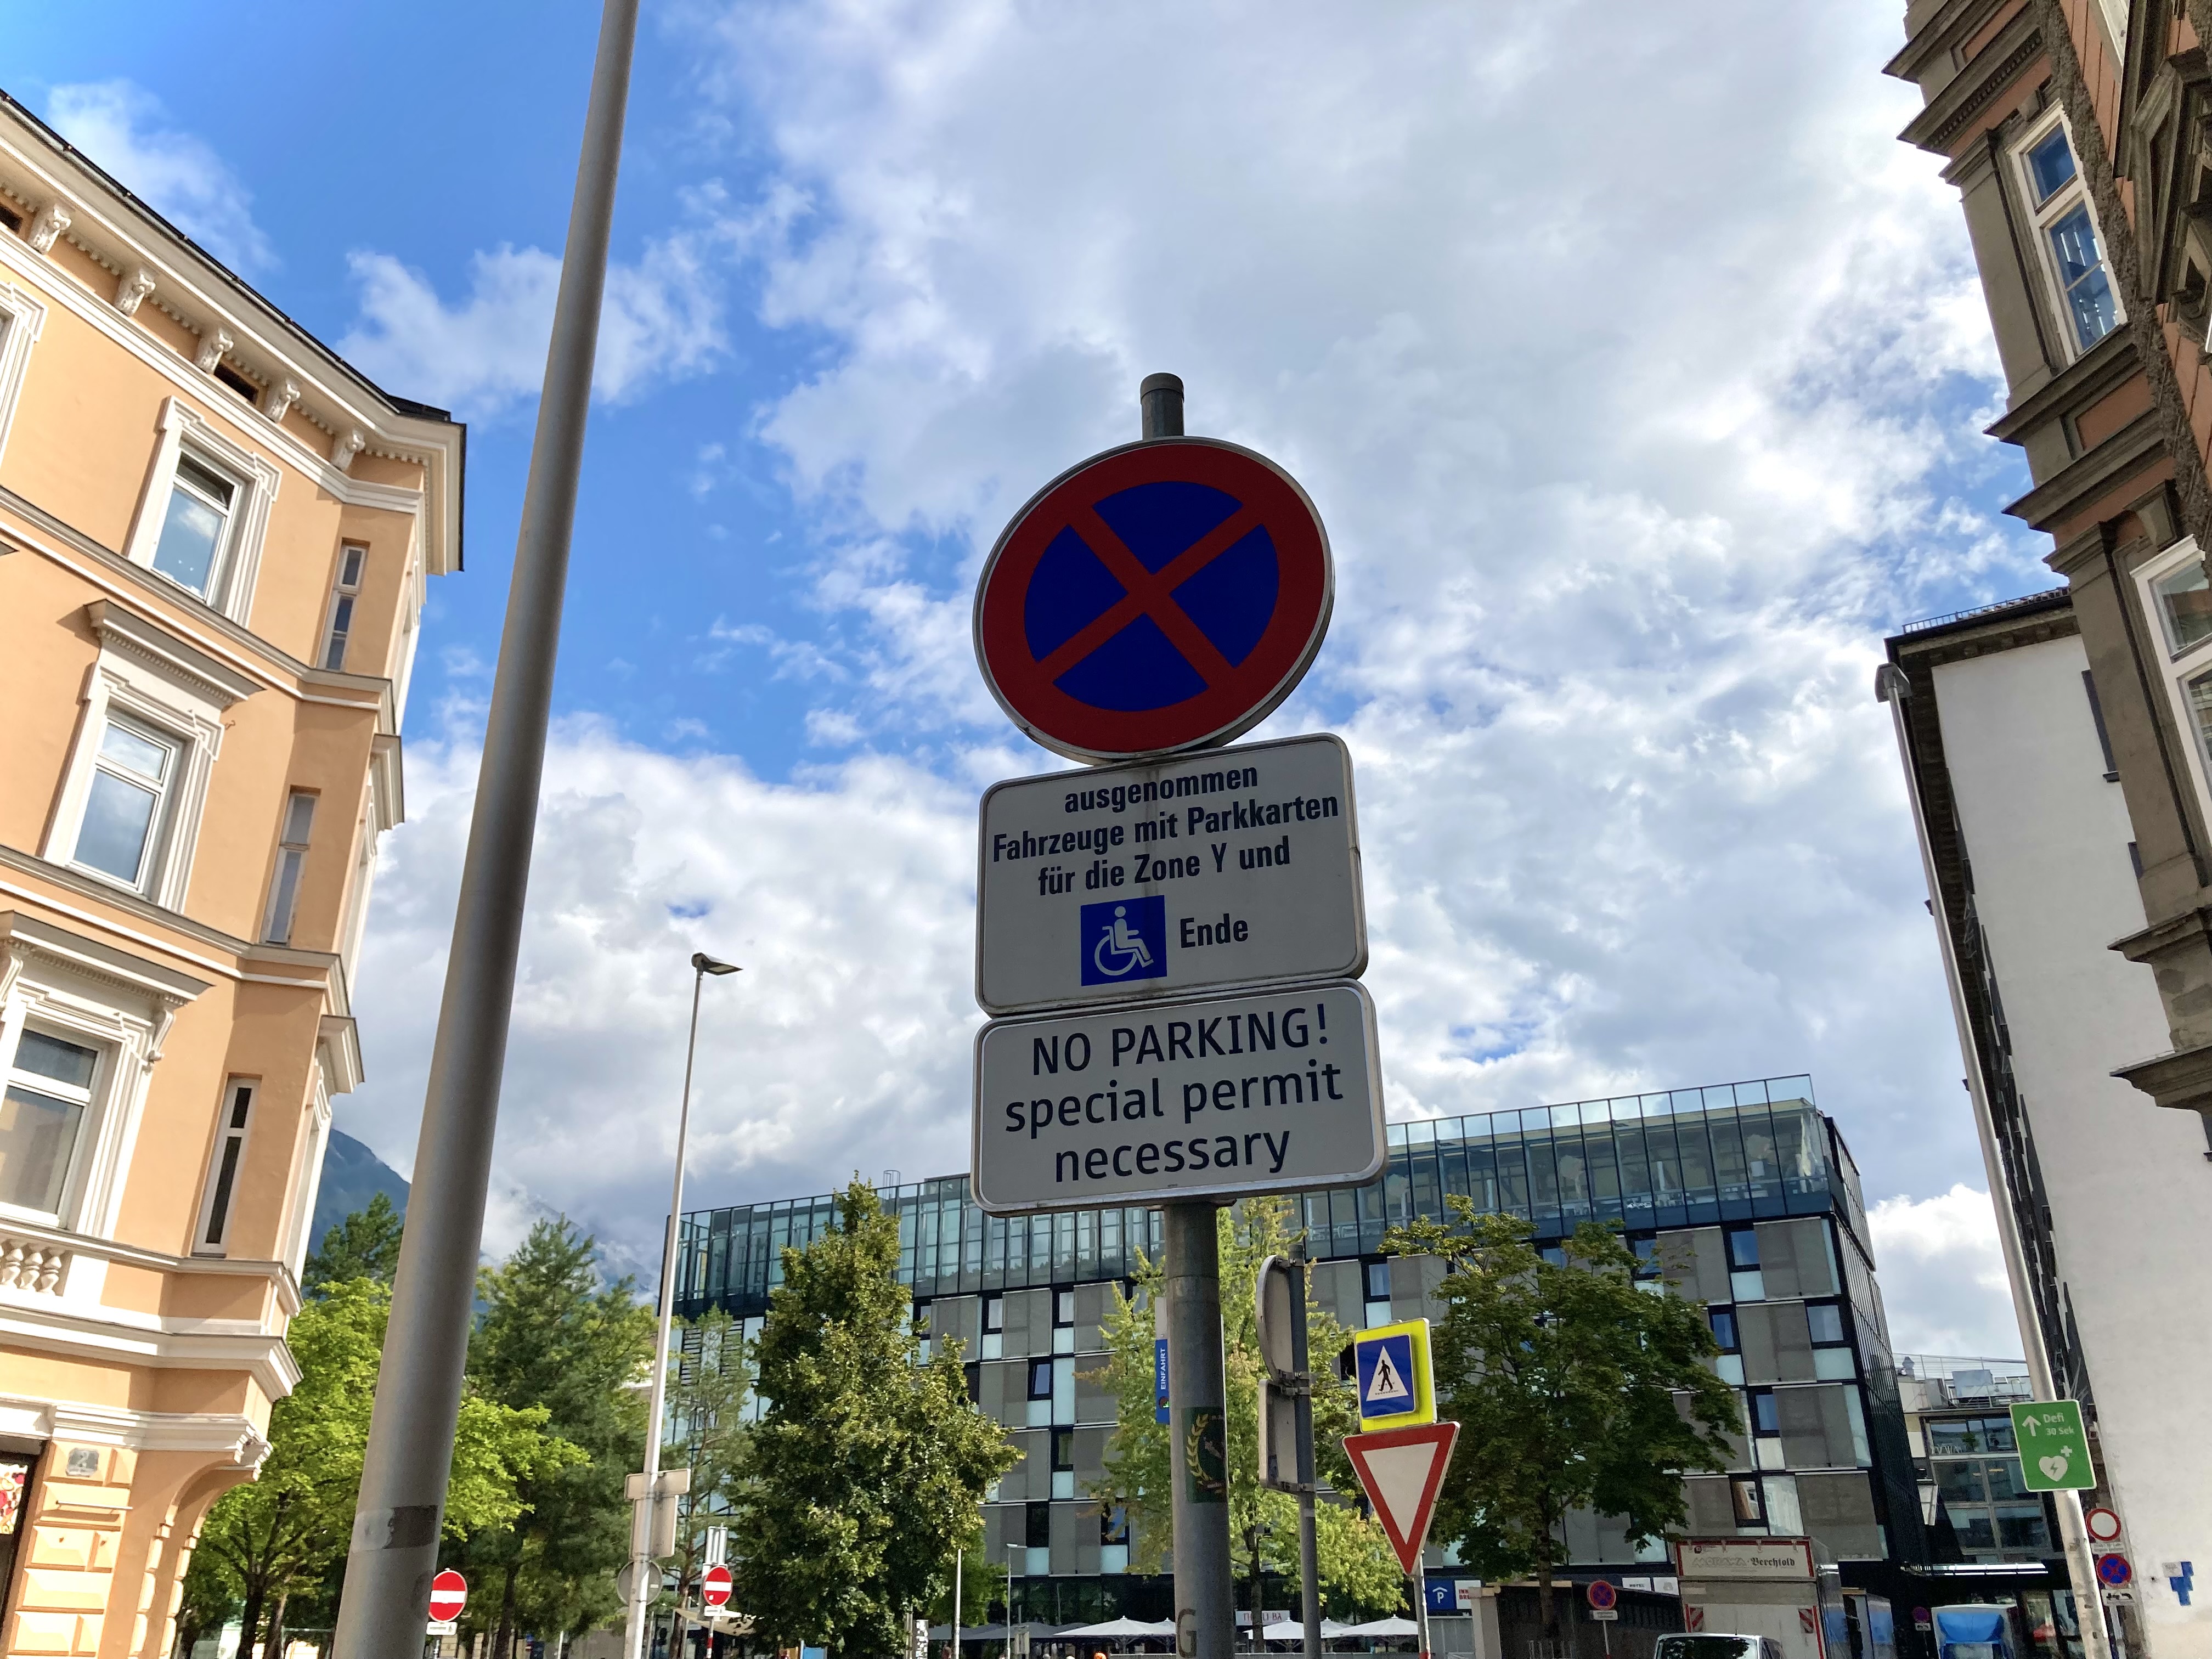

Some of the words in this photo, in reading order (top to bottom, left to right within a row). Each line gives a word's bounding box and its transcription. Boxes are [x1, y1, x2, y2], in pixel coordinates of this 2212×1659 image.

[1064, 767, 1258, 814] ausgenommen
[993, 825, 1124, 862] Fahrzeuge
[1134, 811, 1178, 843] mit
[1187, 795, 1339, 836] Parkkarten
[1037, 866, 1076, 896] für
[1085, 859, 1125, 890] die
[1134, 853, 1200, 884] Zone
[1210, 842, 1227, 873] Y
[1239, 835, 1290, 870] und
[1180, 913, 1249, 949] Ende
[1033, 1032, 1091, 1076] NO
[1112, 1003, 1328, 1067] PARKING!
[1005, 1077, 1165, 1140] special
[1183, 1058, 1344, 1124] permit
[1056, 1130, 1290, 1183] necessary
[2043, 1412, 2064, 1423] Defi
[2046, 1427, 2057, 1436] 30
[2058, 1425, 2075, 1435] Sek
[1437, 1592, 1444, 1604] P
